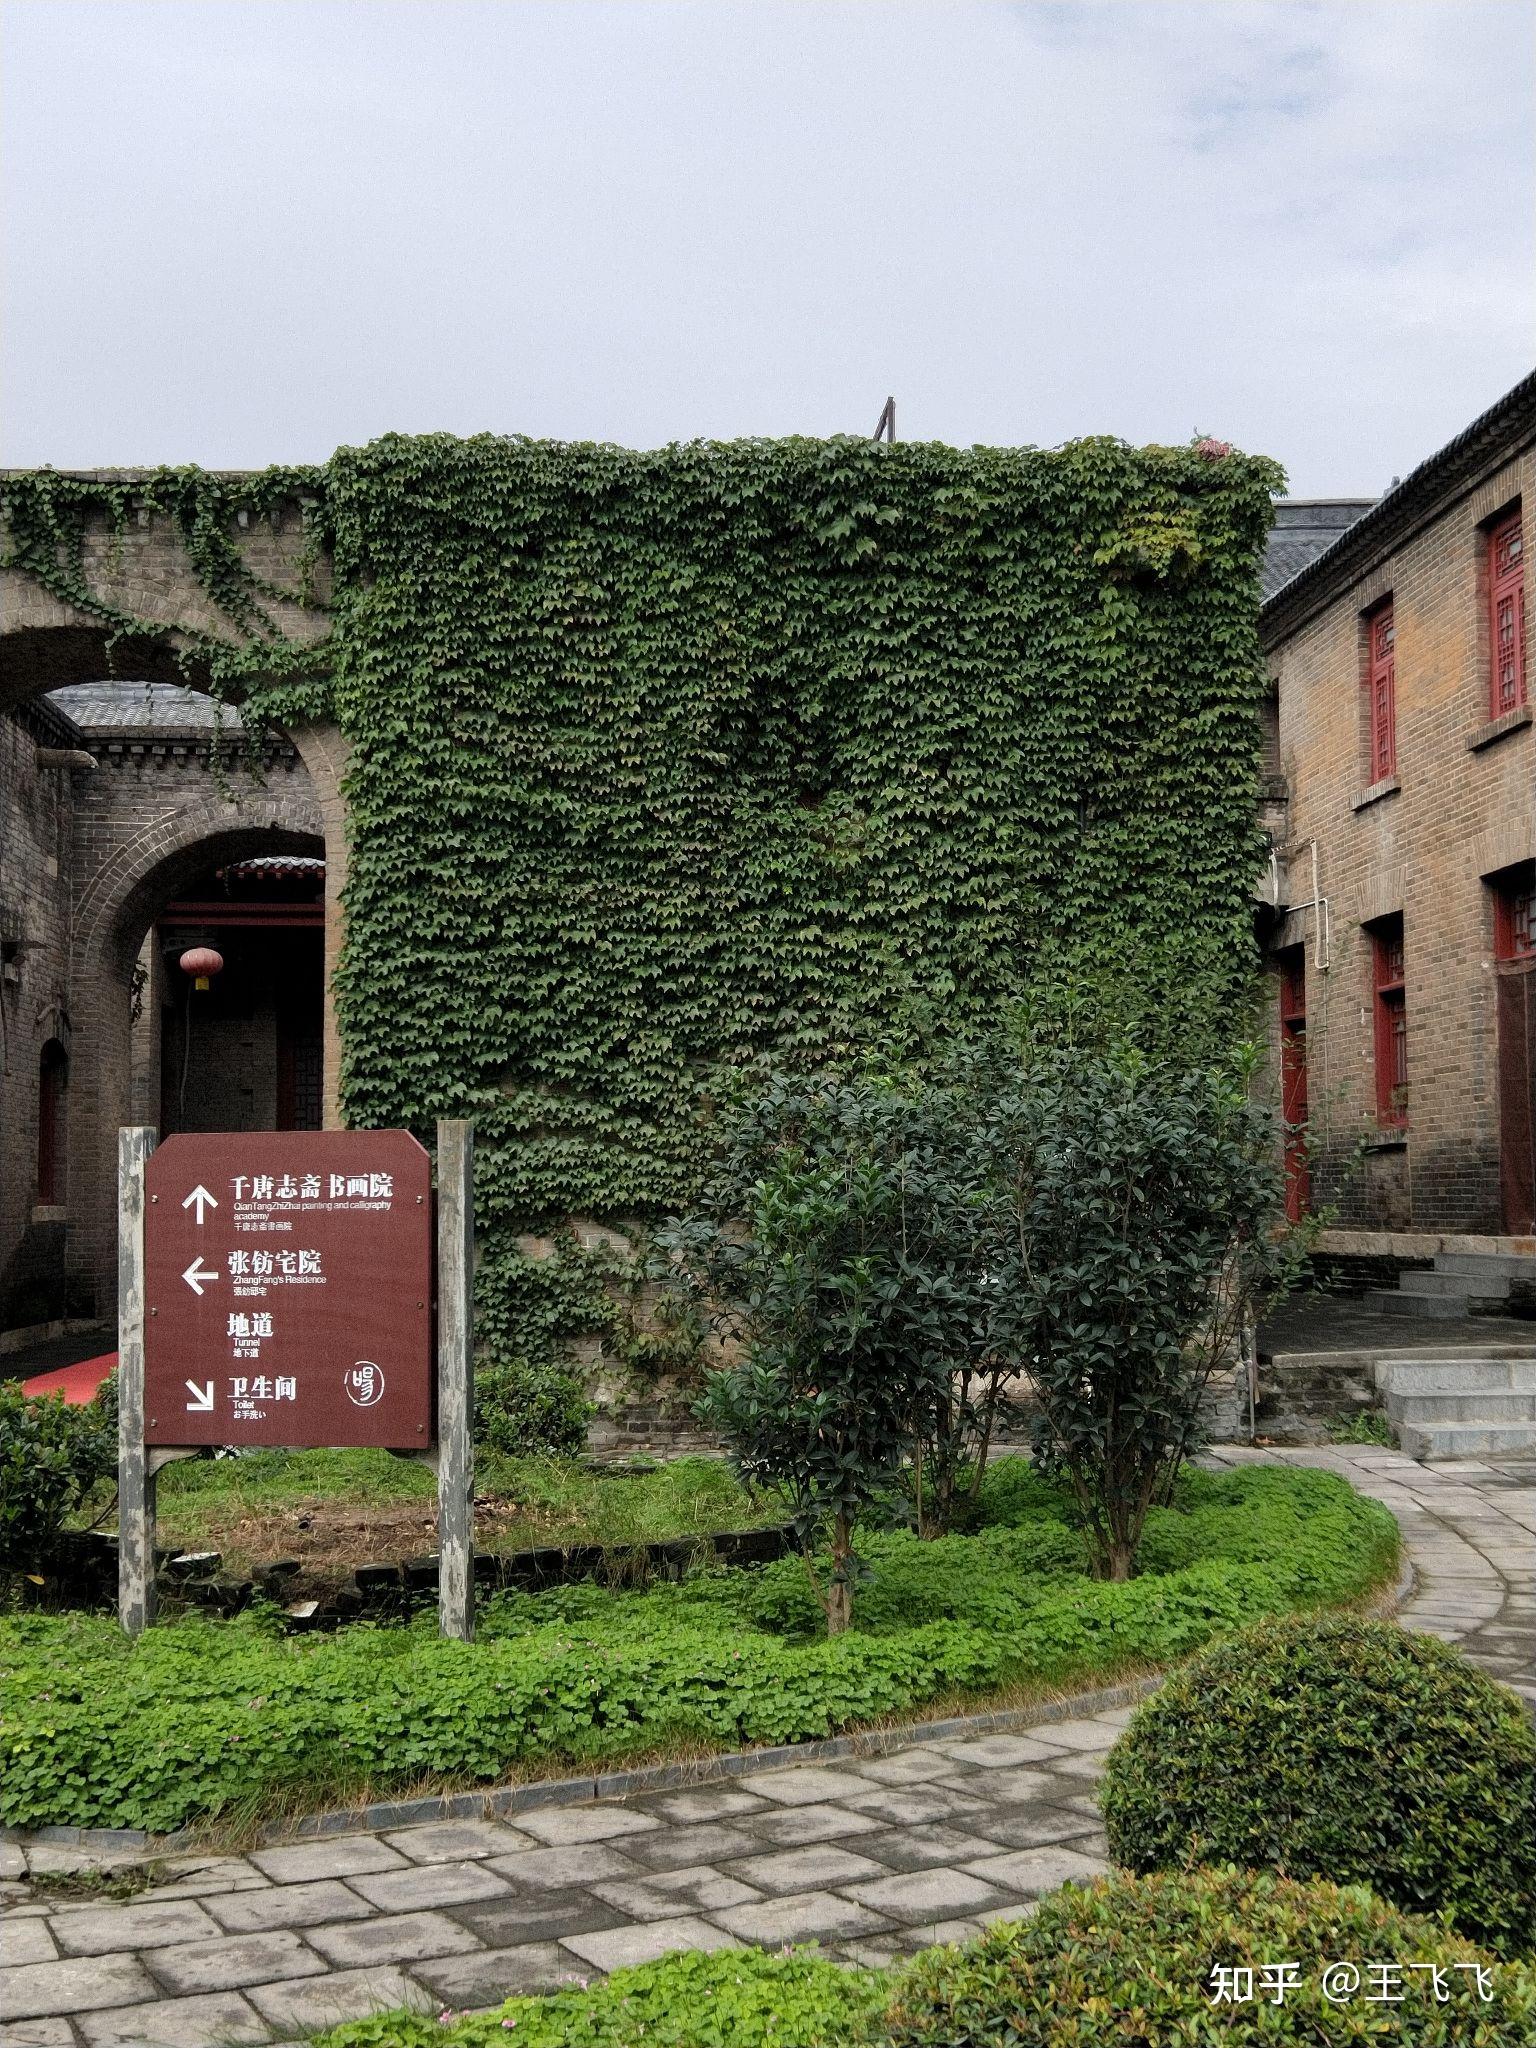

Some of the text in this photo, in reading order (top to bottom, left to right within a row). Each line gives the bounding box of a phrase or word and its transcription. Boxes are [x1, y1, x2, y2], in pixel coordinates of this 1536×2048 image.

[228, 1173, 394, 1200] 千唐志斋书画院
[302, 1201, 332, 1211] painting
[333, 1201, 349, 1210] and
[350, 1201, 392, 1211] calligraphy
[233, 1212, 270, 1221] academy
[227, 1249, 322, 1275] 张钫宅院
[233, 1275, 327, 1285] ZhangFang's Residence
[226, 1312, 274, 1337] 地道
[232, 1337, 261, 1347] Tunnel
[232, 1347, 260, 1358] 地下道
[226, 1375, 297, 1401] 卫生间
[232, 1400, 255, 1409] Toilet
[233, 1409, 267, 1420] お手洗い
